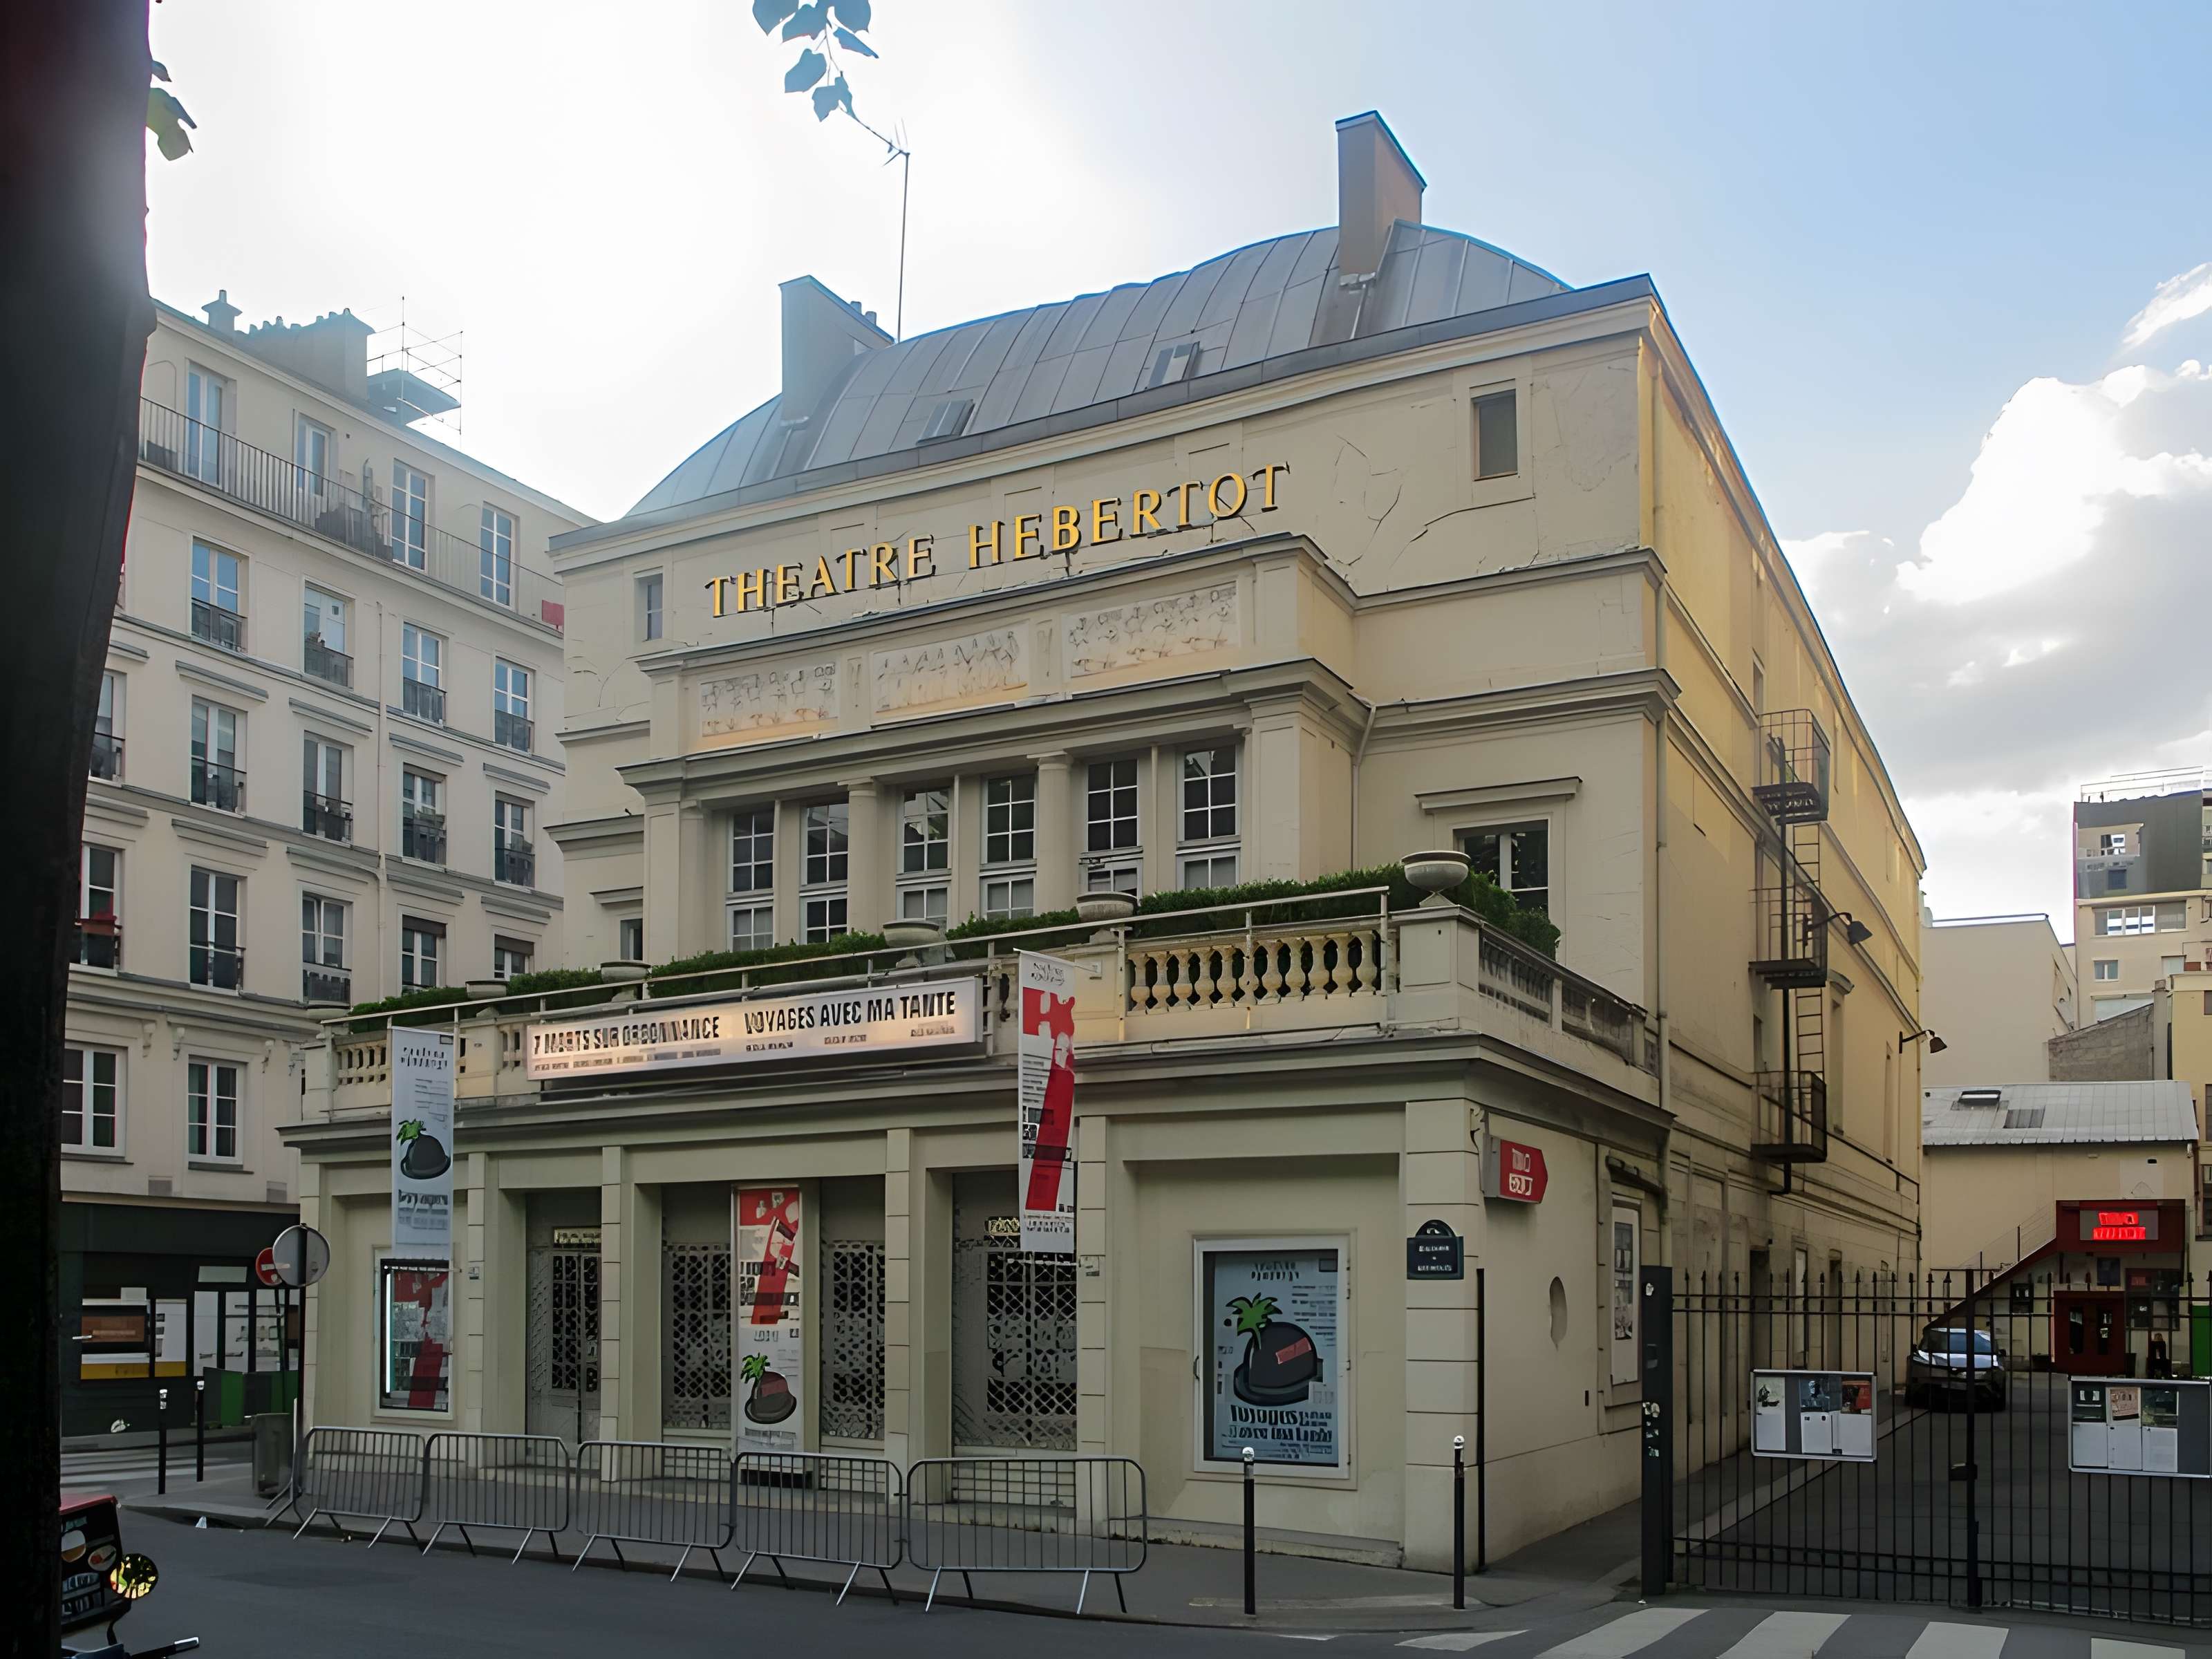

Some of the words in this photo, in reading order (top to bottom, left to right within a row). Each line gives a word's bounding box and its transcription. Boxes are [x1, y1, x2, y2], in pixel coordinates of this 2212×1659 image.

[705, 534, 936, 618] THEATRE
[968, 461, 1290, 570] HEBERTOT
[821, 1001, 862, 1027] AVEC
[867, 997, 895, 1022] MA
[899, 991, 955, 1019] TANTE
